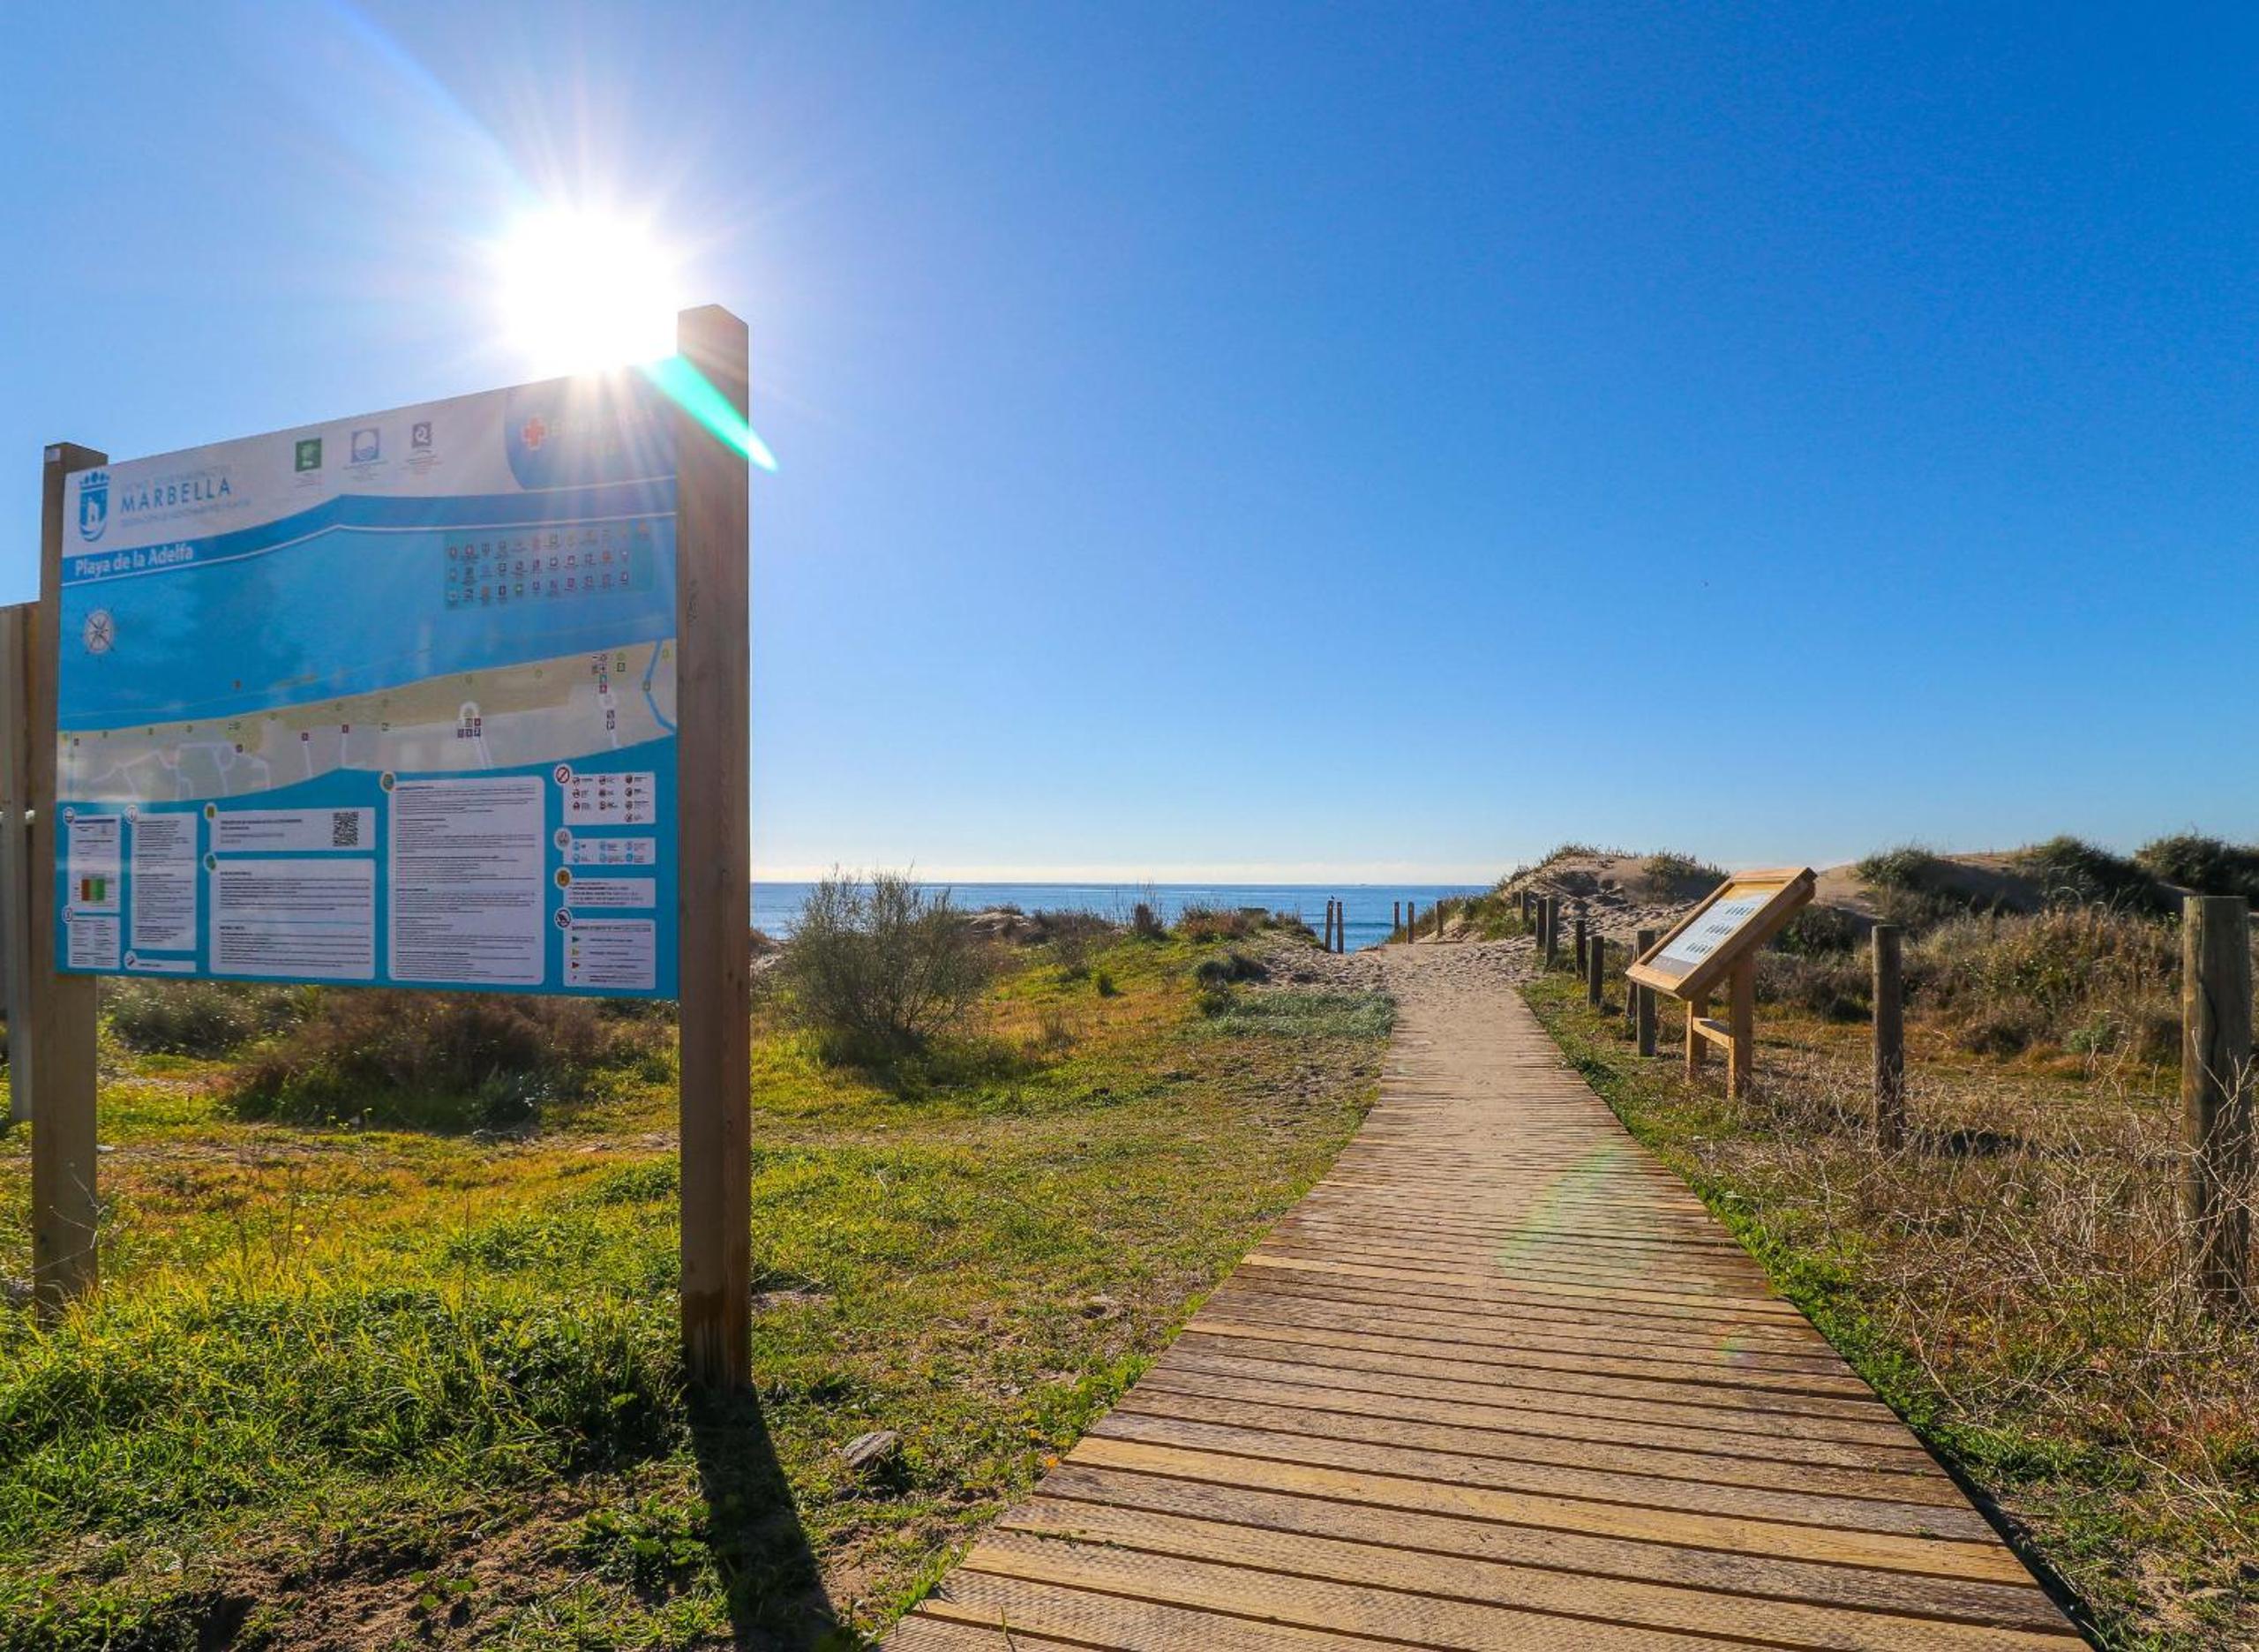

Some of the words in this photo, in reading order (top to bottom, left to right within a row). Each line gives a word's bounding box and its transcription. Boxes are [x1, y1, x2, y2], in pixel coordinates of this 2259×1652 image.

[121, 477, 230, 513] MARBELLA
[75, 557, 111, 578] Playa
[113, 552, 131, 570] de
[132, 549, 146, 567] la
[146, 542, 194, 566] Adelfa
